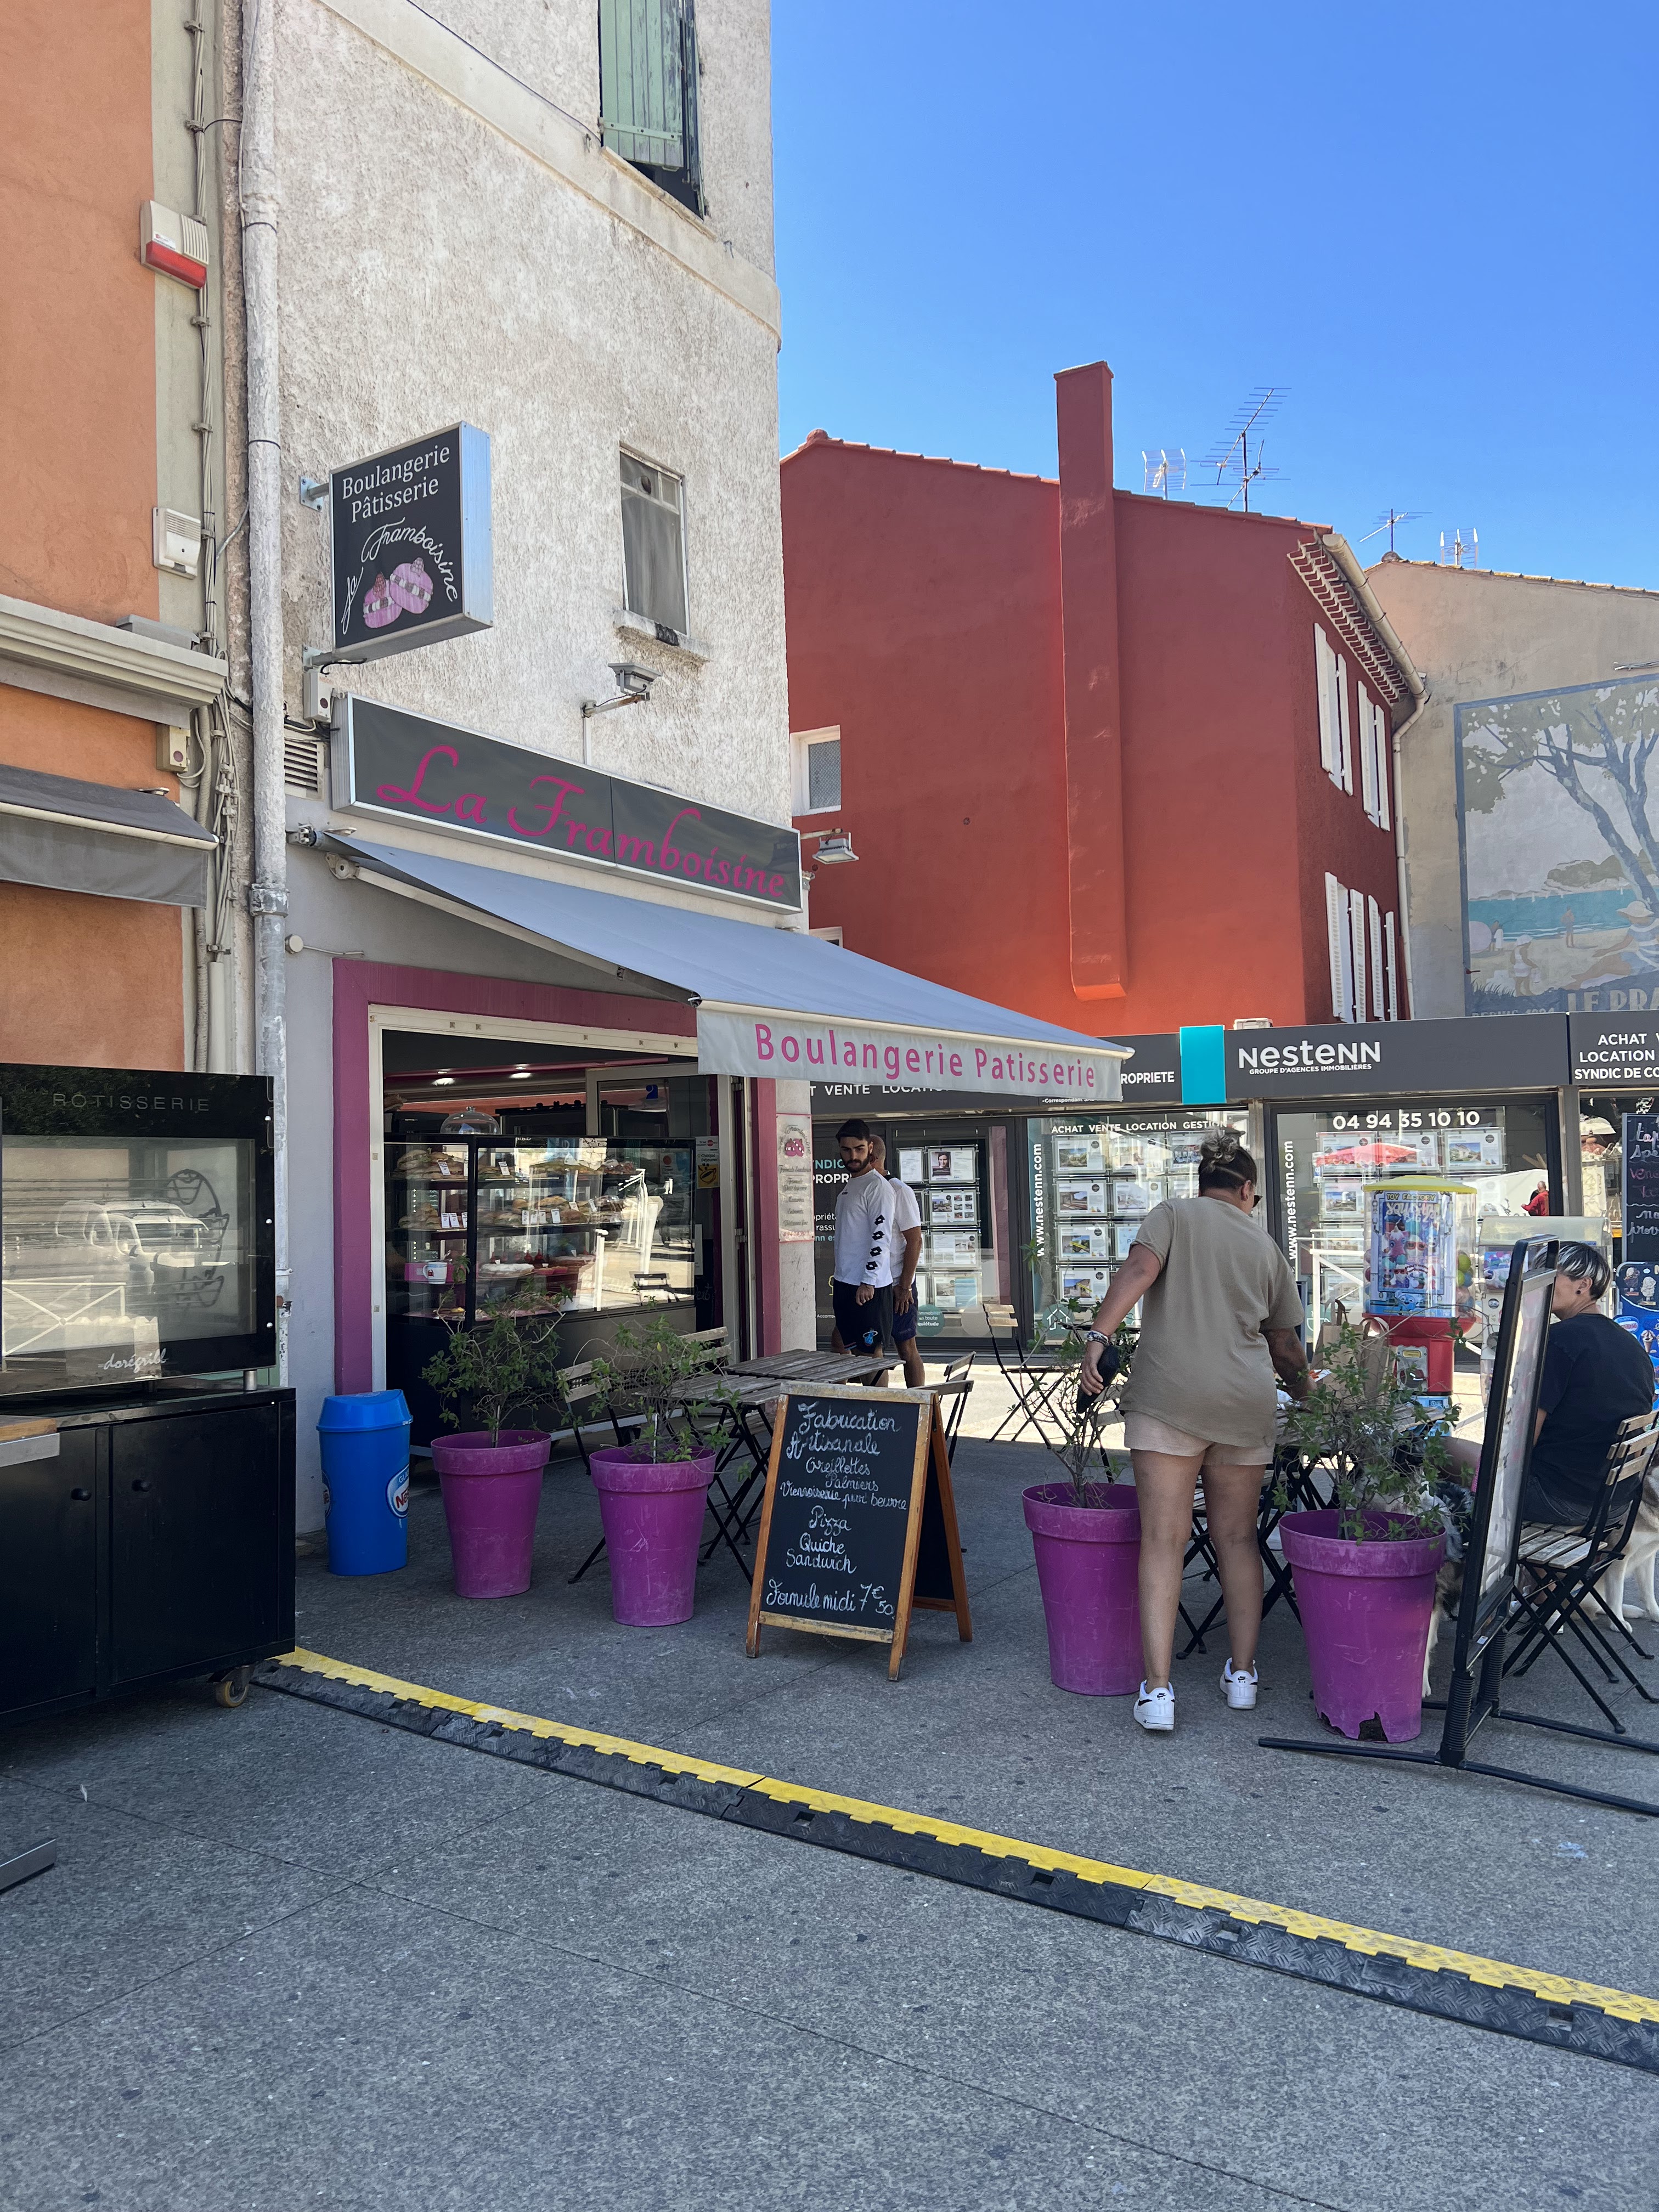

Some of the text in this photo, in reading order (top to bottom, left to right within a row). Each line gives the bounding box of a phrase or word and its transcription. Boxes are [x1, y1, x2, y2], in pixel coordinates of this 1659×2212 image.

[342, 445, 450, 499] Boulangerie
[352, 477, 439, 523] Pâtisserie
[360, 517, 458, 602] Framboisine
[319, 676, 334, 685] NEON
[376, 744, 785, 897] La Framboisine
[1598, 1033, 1647, 1046] ACHAT
[755, 1023, 1096, 1089] Boulangerie Patisserie
[1579, 1049, 1655, 1063] LOCATION
[1321, 1063, 1372, 1071] IMMOBILIÈRES
[1575, 1068, 1621, 1080] SYNDIC
[1624, 1067, 1641, 1079] DE
[825, 1084, 871, 1096] VENTE
[53, 1093, 210, 1112] ROTISSERIE
[1051, 1125, 1084, 1133] ACHAT
[1088, 1124, 1121, 1133] VENTE
[1126, 1122, 1177, 1131] LOCATION
[1333, 1111, 1480, 1130] 04 94 35 10 10
[813, 1160, 845, 1169] NDIC
[813, 1173, 851, 1184] ROPR
[1284, 1141, 1298, 1260] www.nestenn.com
[797, 1401, 902, 1435] Fabrication
[786, 1430, 881, 1459] Artisanale
[805, 1455, 871, 1475] Oreillettes
[871, 1492, 907, 1510] beurre
[808, 1505, 852, 1536] Pizza
[799, 1532, 846, 1555] Quiche
[786, 1548, 857, 1575] Sandwich
[823, 1590, 856, 1611] midi
